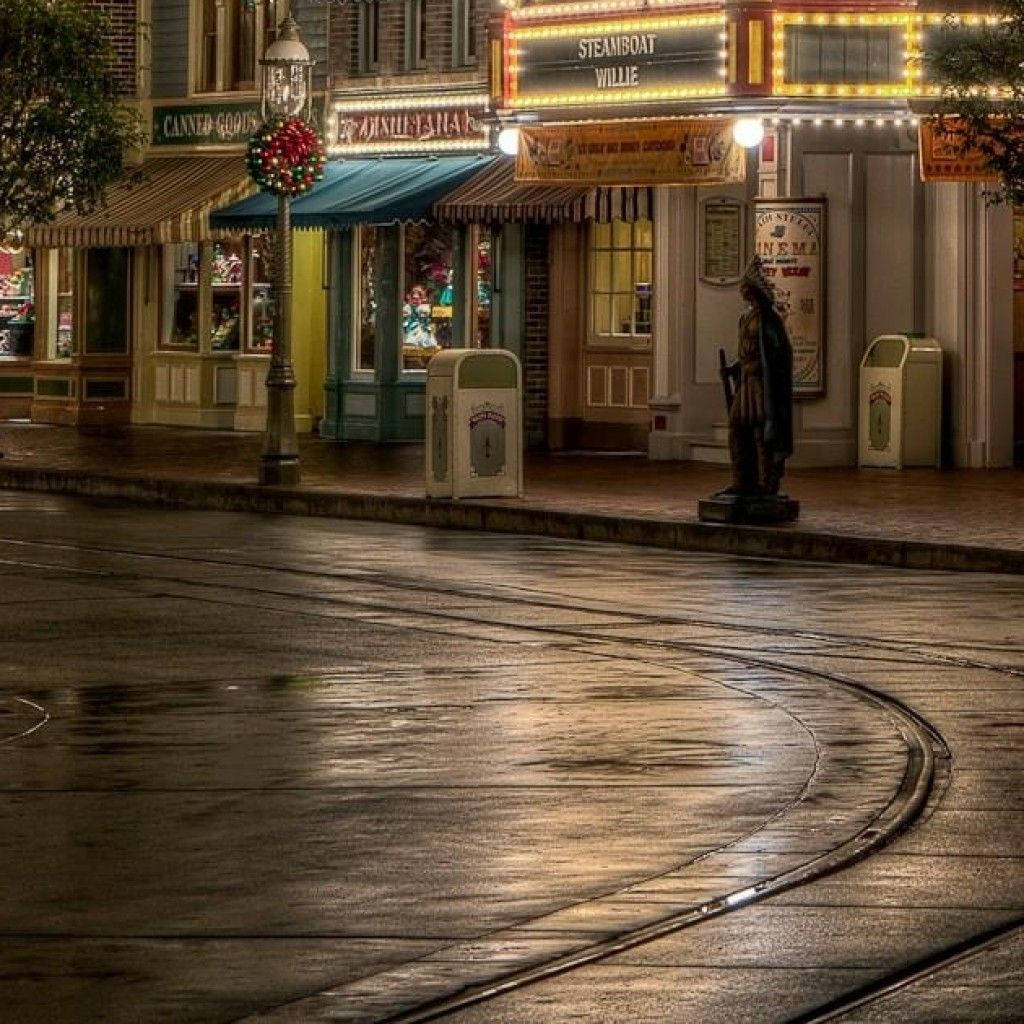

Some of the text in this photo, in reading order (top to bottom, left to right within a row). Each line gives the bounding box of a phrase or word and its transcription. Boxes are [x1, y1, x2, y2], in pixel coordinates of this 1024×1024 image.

[578, 33, 657, 58] STEAMBOAT
[594, 65, 640, 89] WILLIE
[163, 113, 213, 138] CANNED
